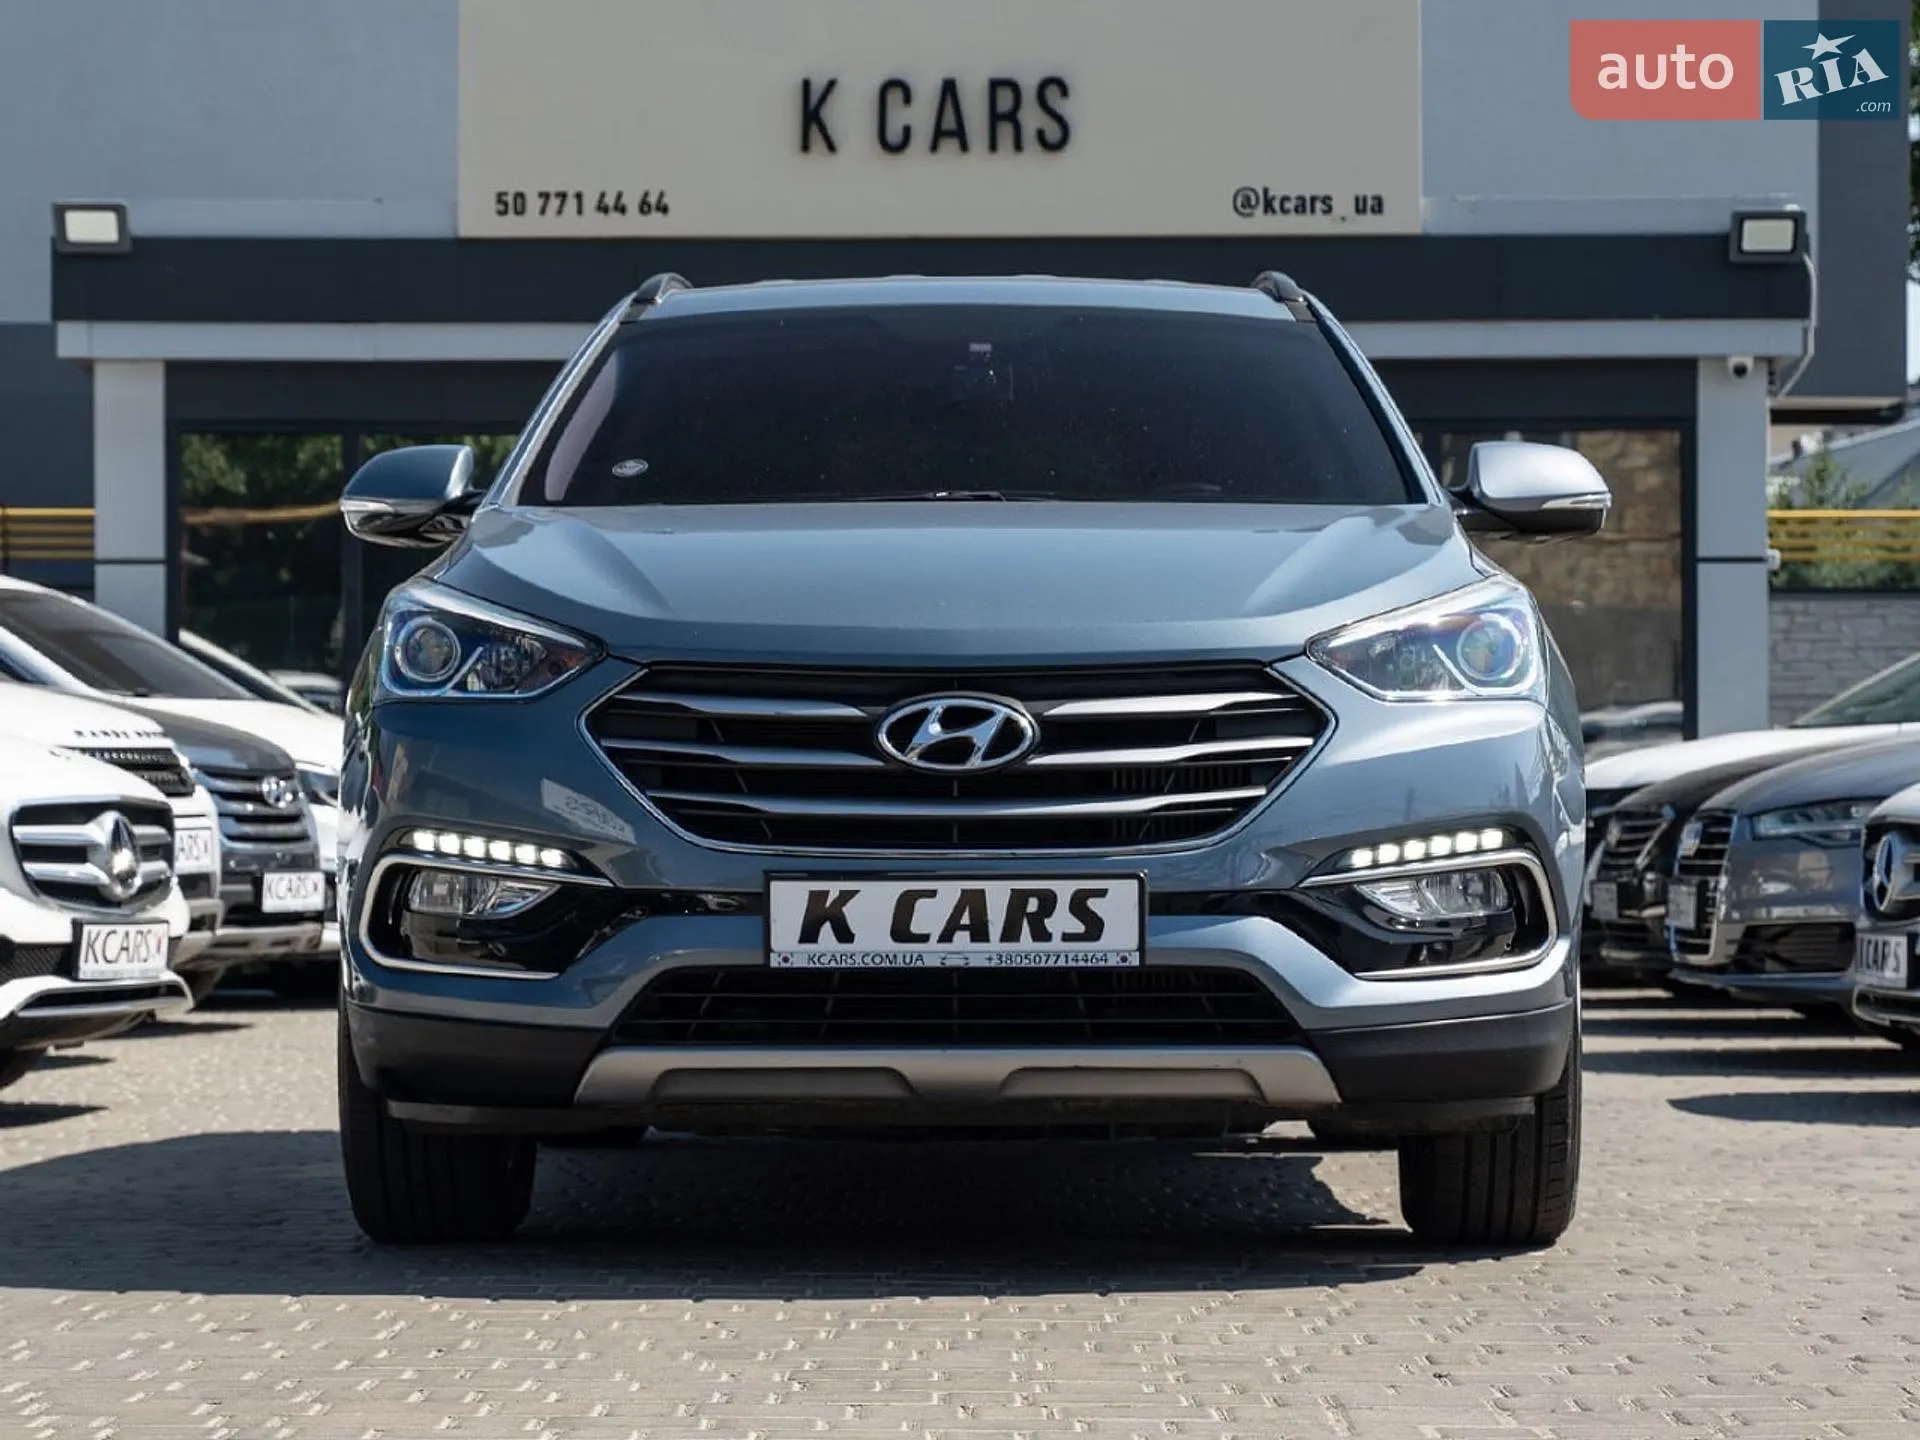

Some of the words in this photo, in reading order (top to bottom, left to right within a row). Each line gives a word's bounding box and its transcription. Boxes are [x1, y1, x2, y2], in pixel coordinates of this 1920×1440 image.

[801, 77, 838, 154] K
[877, 76, 1071, 154] CARS
[495, 190, 527, 216] 50
[537, 190, 584, 216] 771
[595, 190, 627, 216] 44
[638, 190, 669, 216] 64
[798, 888, 861, 944] K
[889, 888, 1109, 944] CARS
[806, 953, 925, 966] KCARS.COM.UA
[985, 953, 1109, 966] +380507714464
